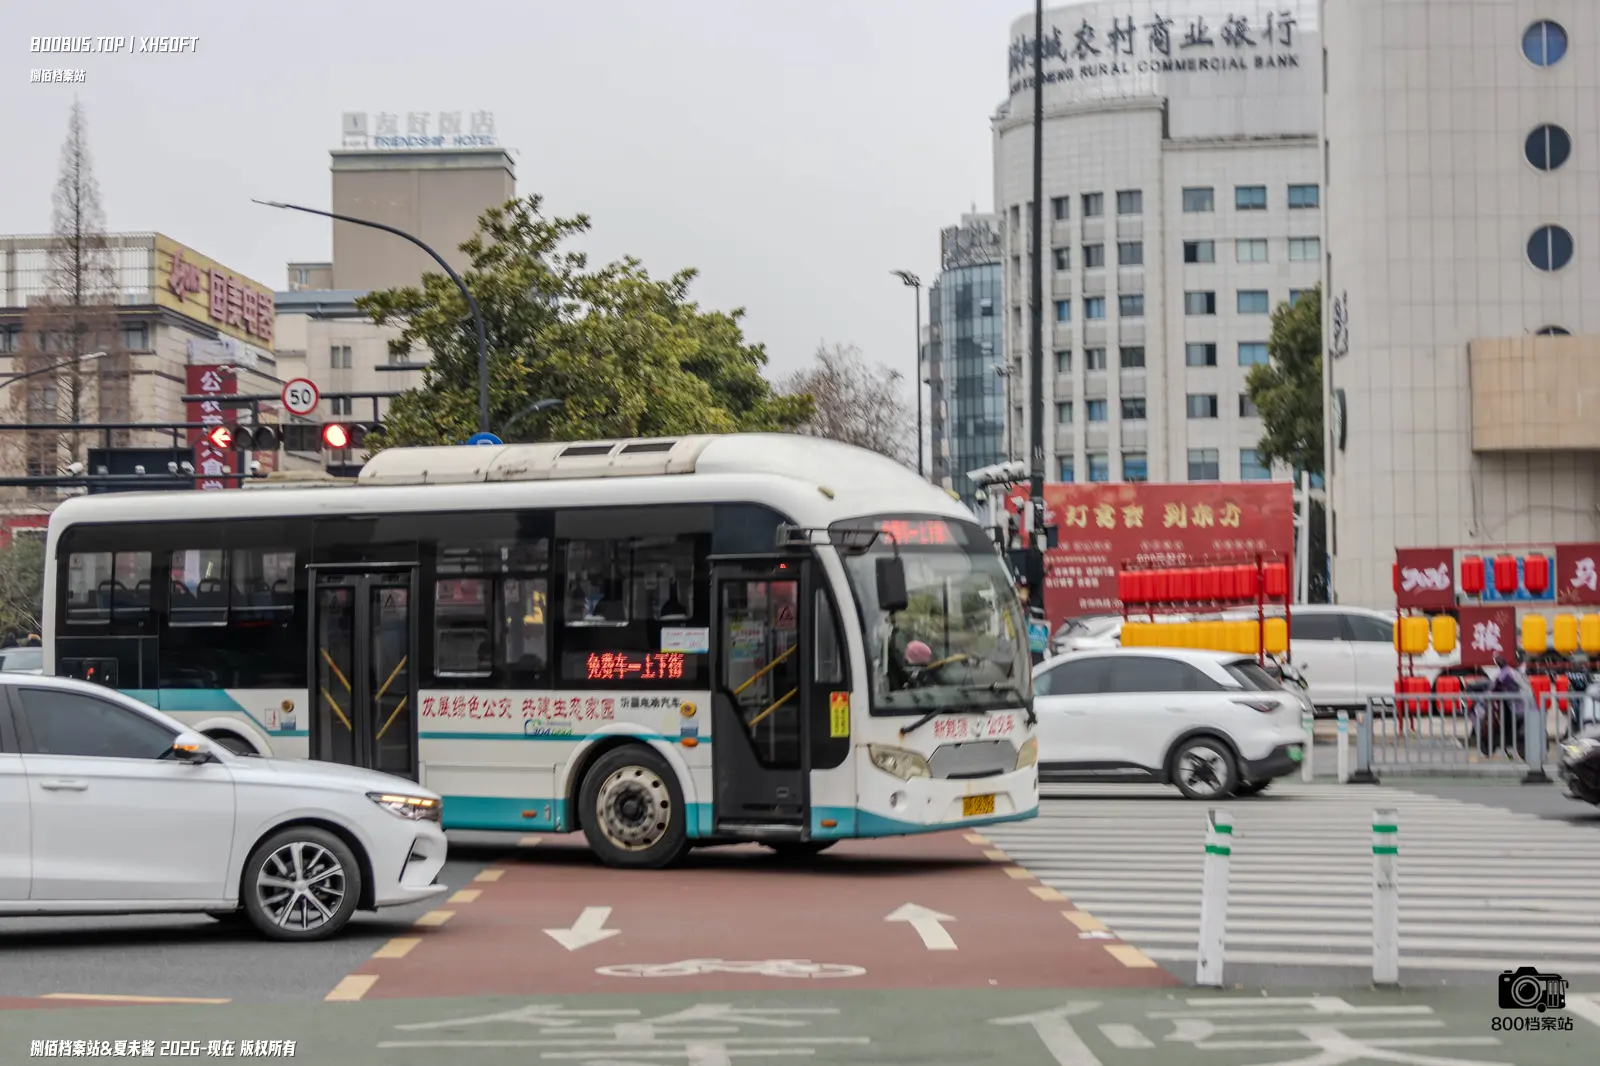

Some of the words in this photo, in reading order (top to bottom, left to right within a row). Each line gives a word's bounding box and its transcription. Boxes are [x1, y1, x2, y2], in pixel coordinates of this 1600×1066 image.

[1080, 61, 1130, 77] RURAL
[1138, 57, 1248, 73] COMMERCIAL
[1254, 53, 1300, 69] BANK
[374, 134, 444, 147] FRIENDSHIP
[452, 133, 496, 146] HOTEL
[208, 266, 274, 341] 国美电器
[290, 389, 311, 405] 50
[422, 695, 513, 720] 发展绿色公交
[521, 695, 616, 720] 共建生态家园
